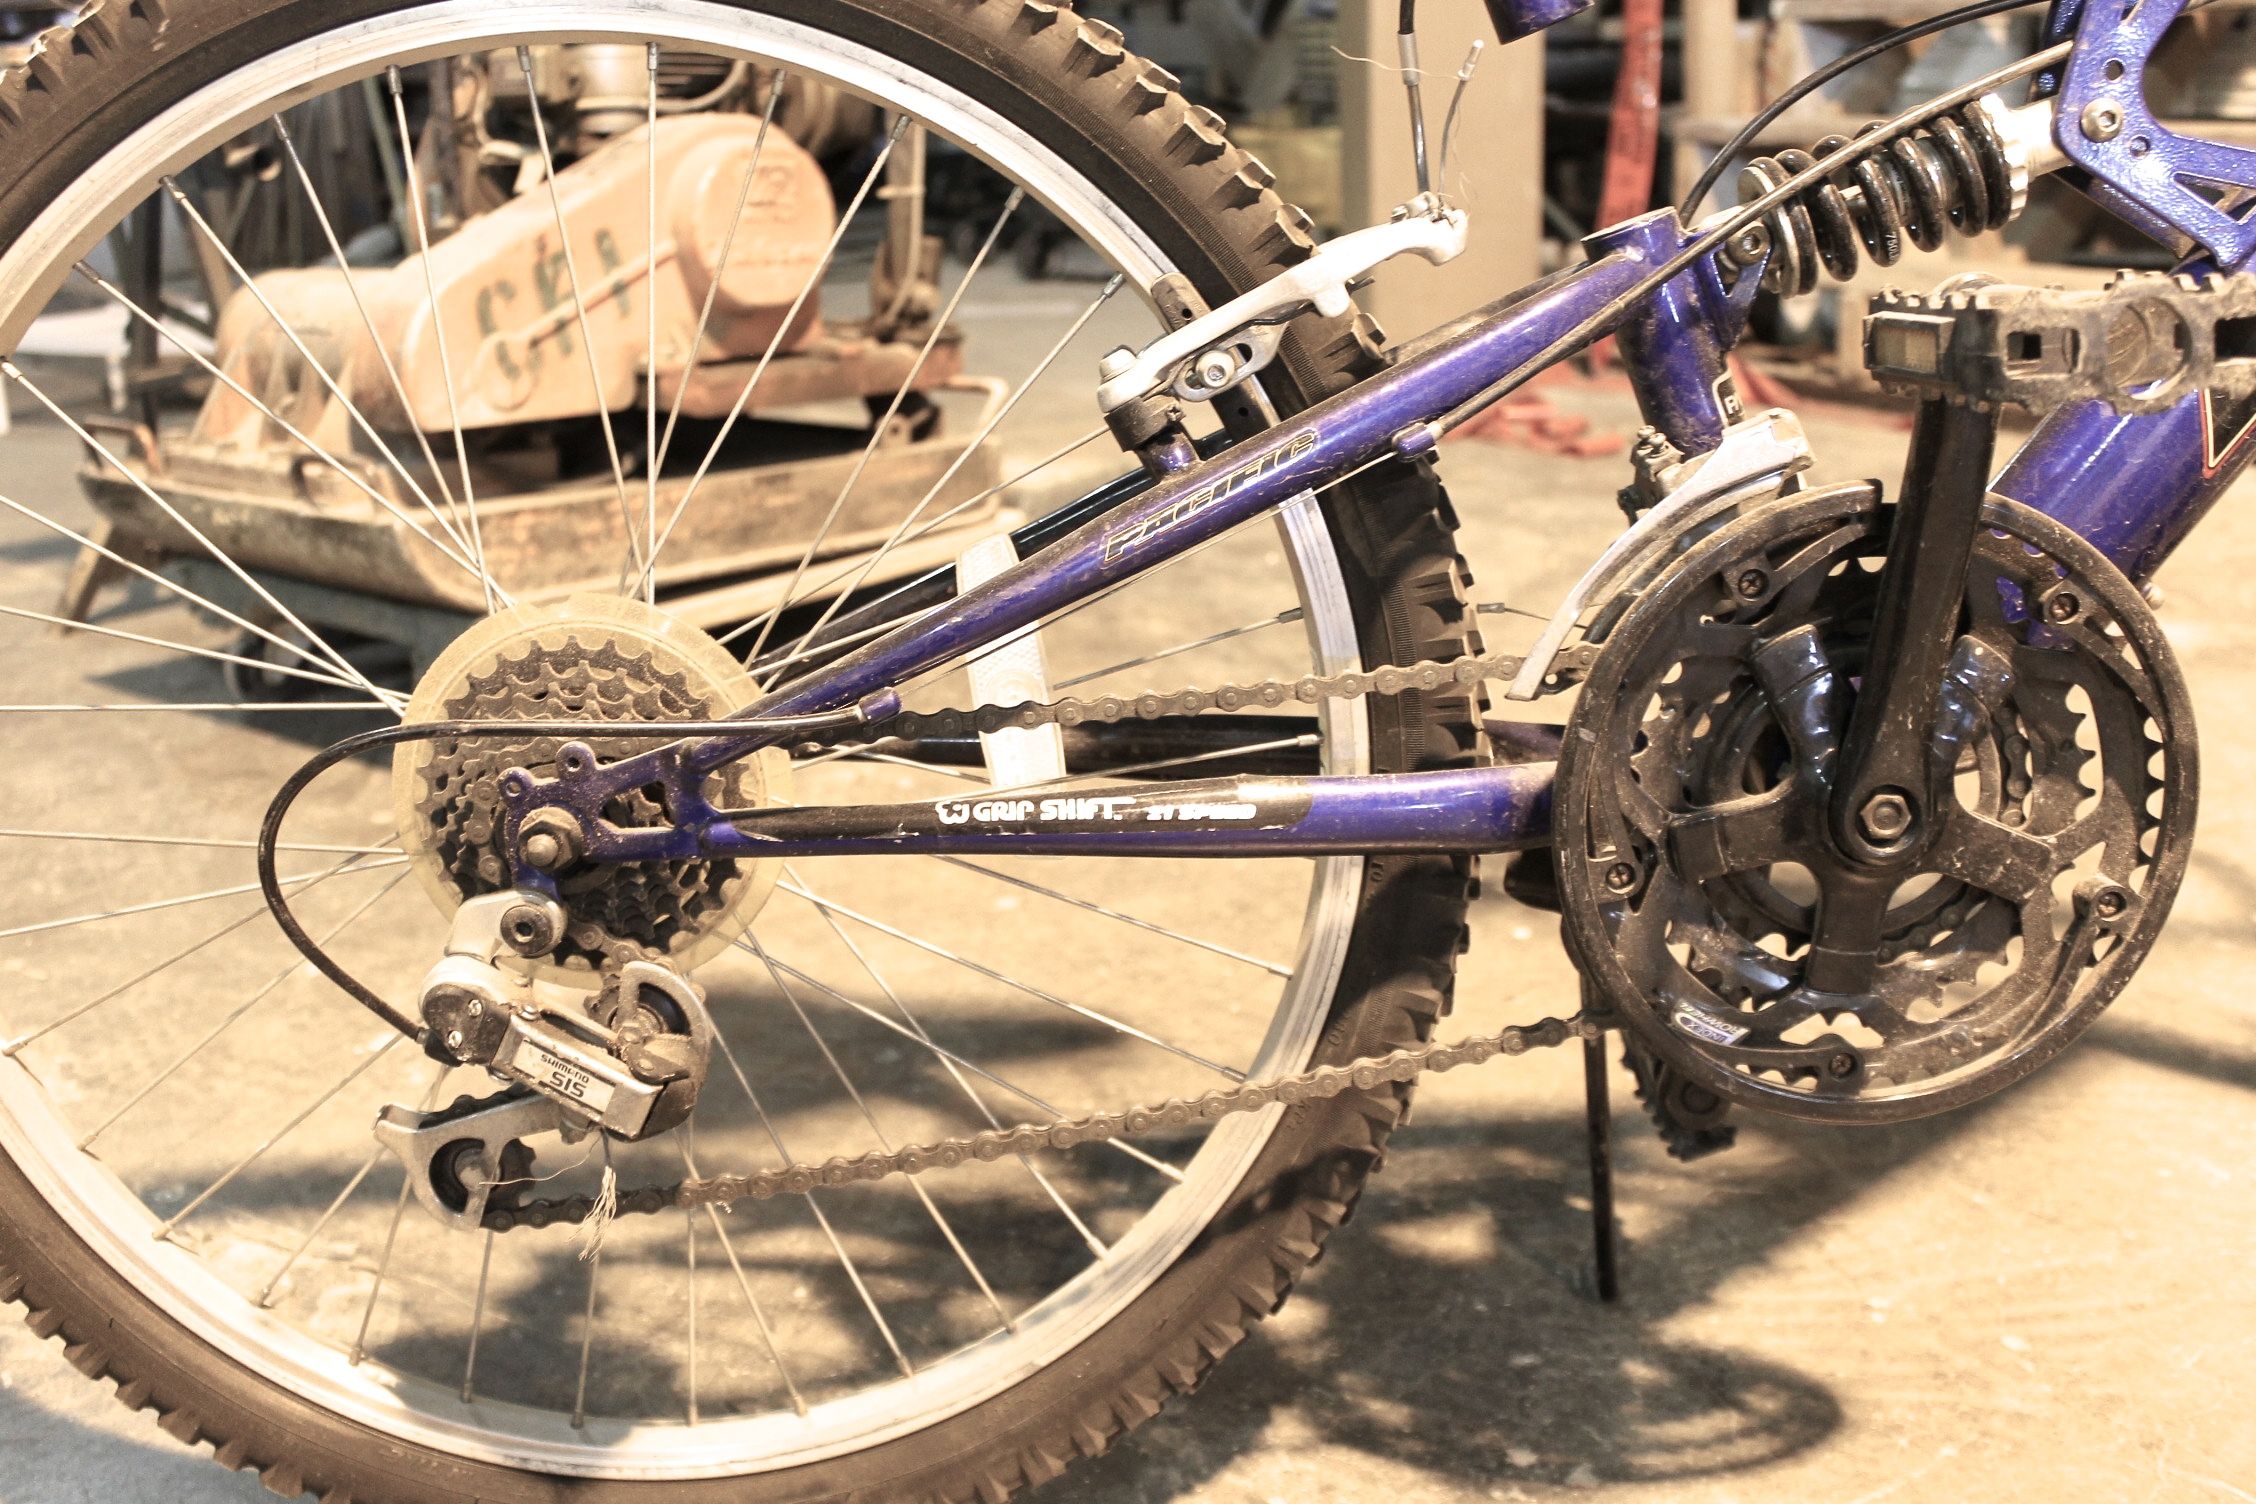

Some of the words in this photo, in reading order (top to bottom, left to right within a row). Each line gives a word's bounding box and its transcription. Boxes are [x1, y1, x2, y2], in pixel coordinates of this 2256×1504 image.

[1104, 427, 1320, 561] PACIFIC
[973, 801, 1035, 822] GRIP
[549, 1071, 588, 1098] SIS
